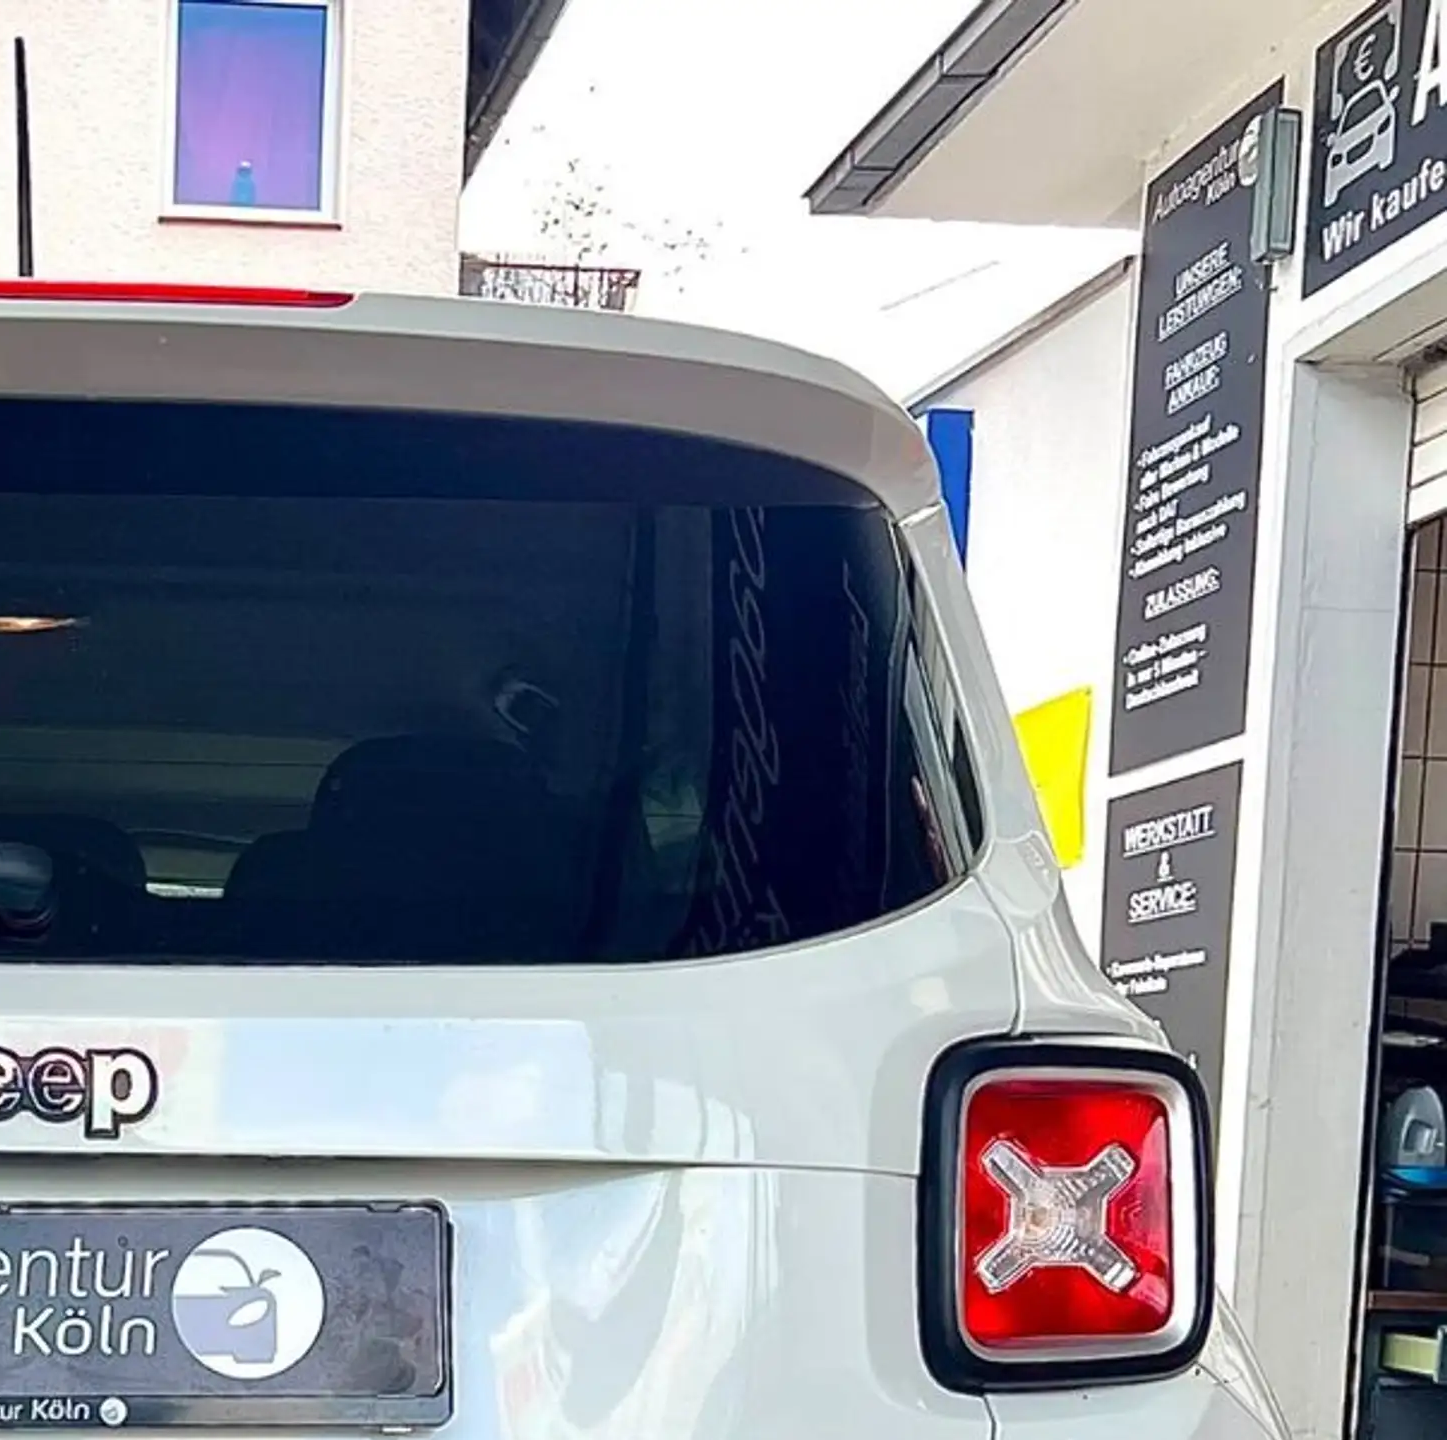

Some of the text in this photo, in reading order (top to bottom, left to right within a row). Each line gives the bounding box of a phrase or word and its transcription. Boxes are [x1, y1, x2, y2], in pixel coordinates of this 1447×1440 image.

[1322, 157, 1446, 262] Wir kaufe
[1124, 806, 1214, 853] WERKSTATT
[13, 1305, 157, 1357] Köln
[31, 1397, 90, 1421] Köln
